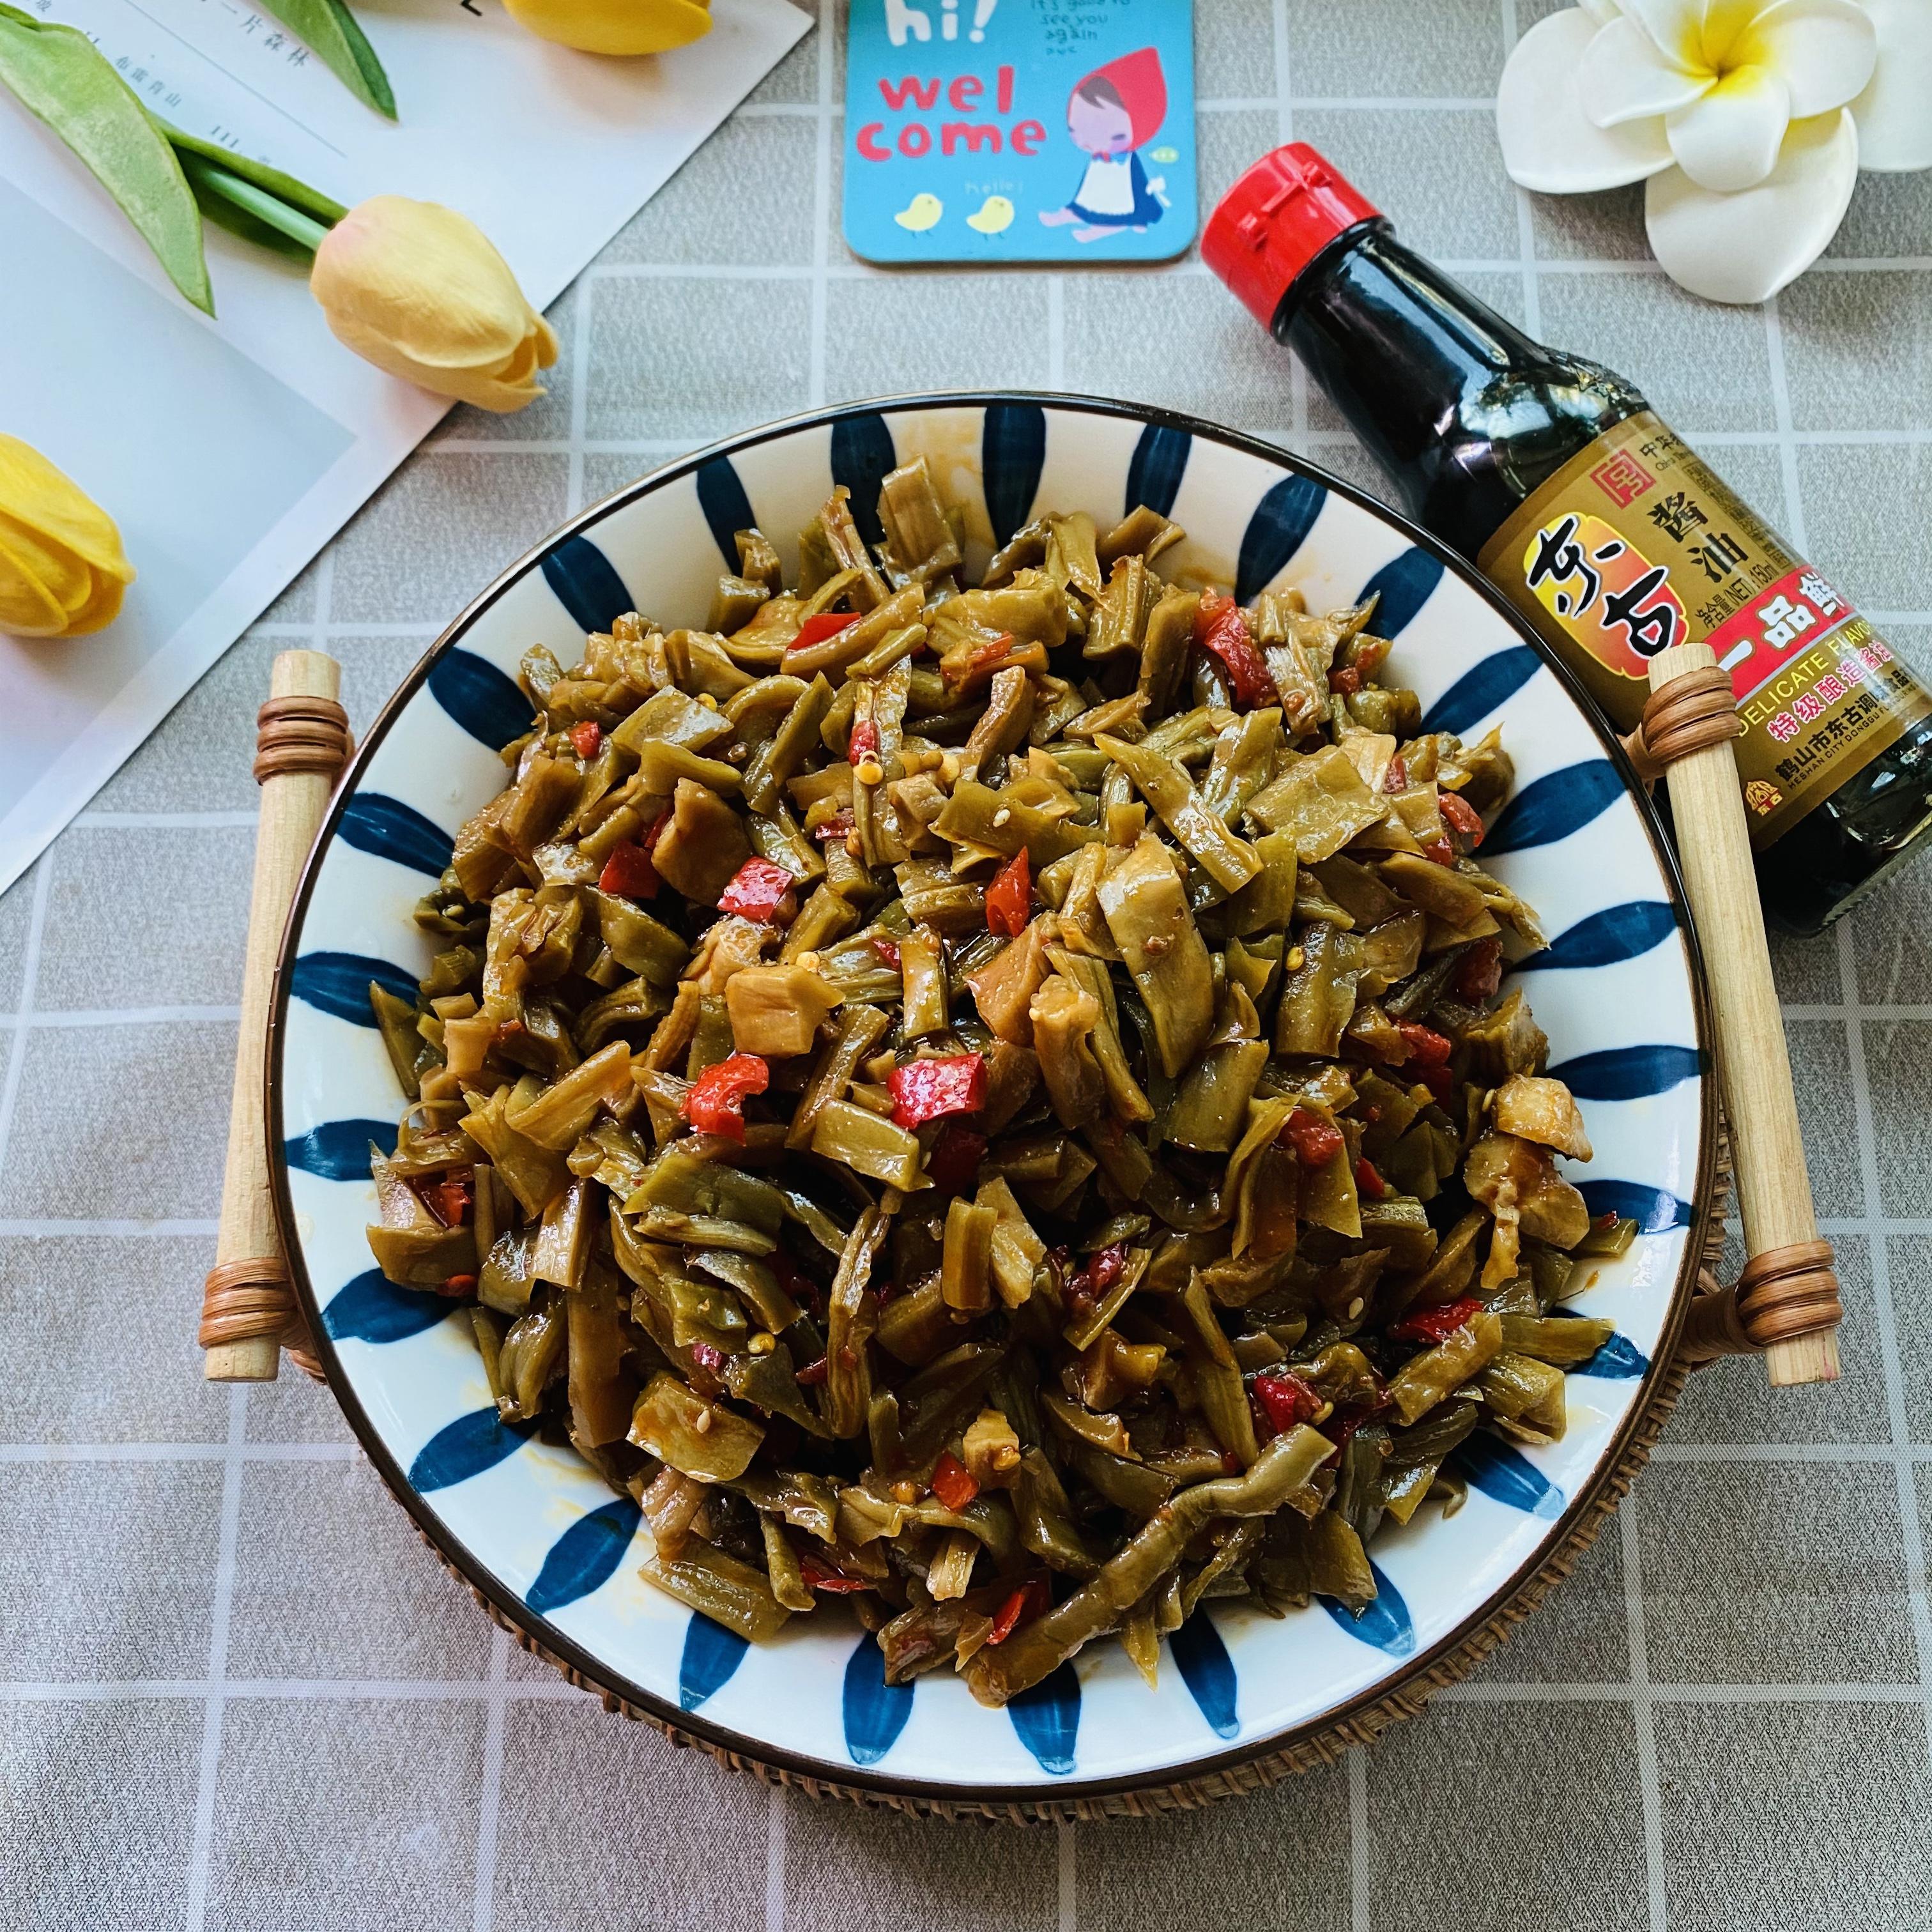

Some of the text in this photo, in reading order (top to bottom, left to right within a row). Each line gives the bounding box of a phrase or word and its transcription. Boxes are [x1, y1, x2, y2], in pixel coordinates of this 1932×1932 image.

[884, 0, 997, 46] hi!
[878, 64, 1015, 114] wel
[856, 119, 1047, 162] come
[1646, 491, 1749, 583] 酱油
[1788, 757, 1825, 790] HESHAN
[1825, 739, 1845, 758] CITY
[1844, 713, 1880, 742] DONGGU
